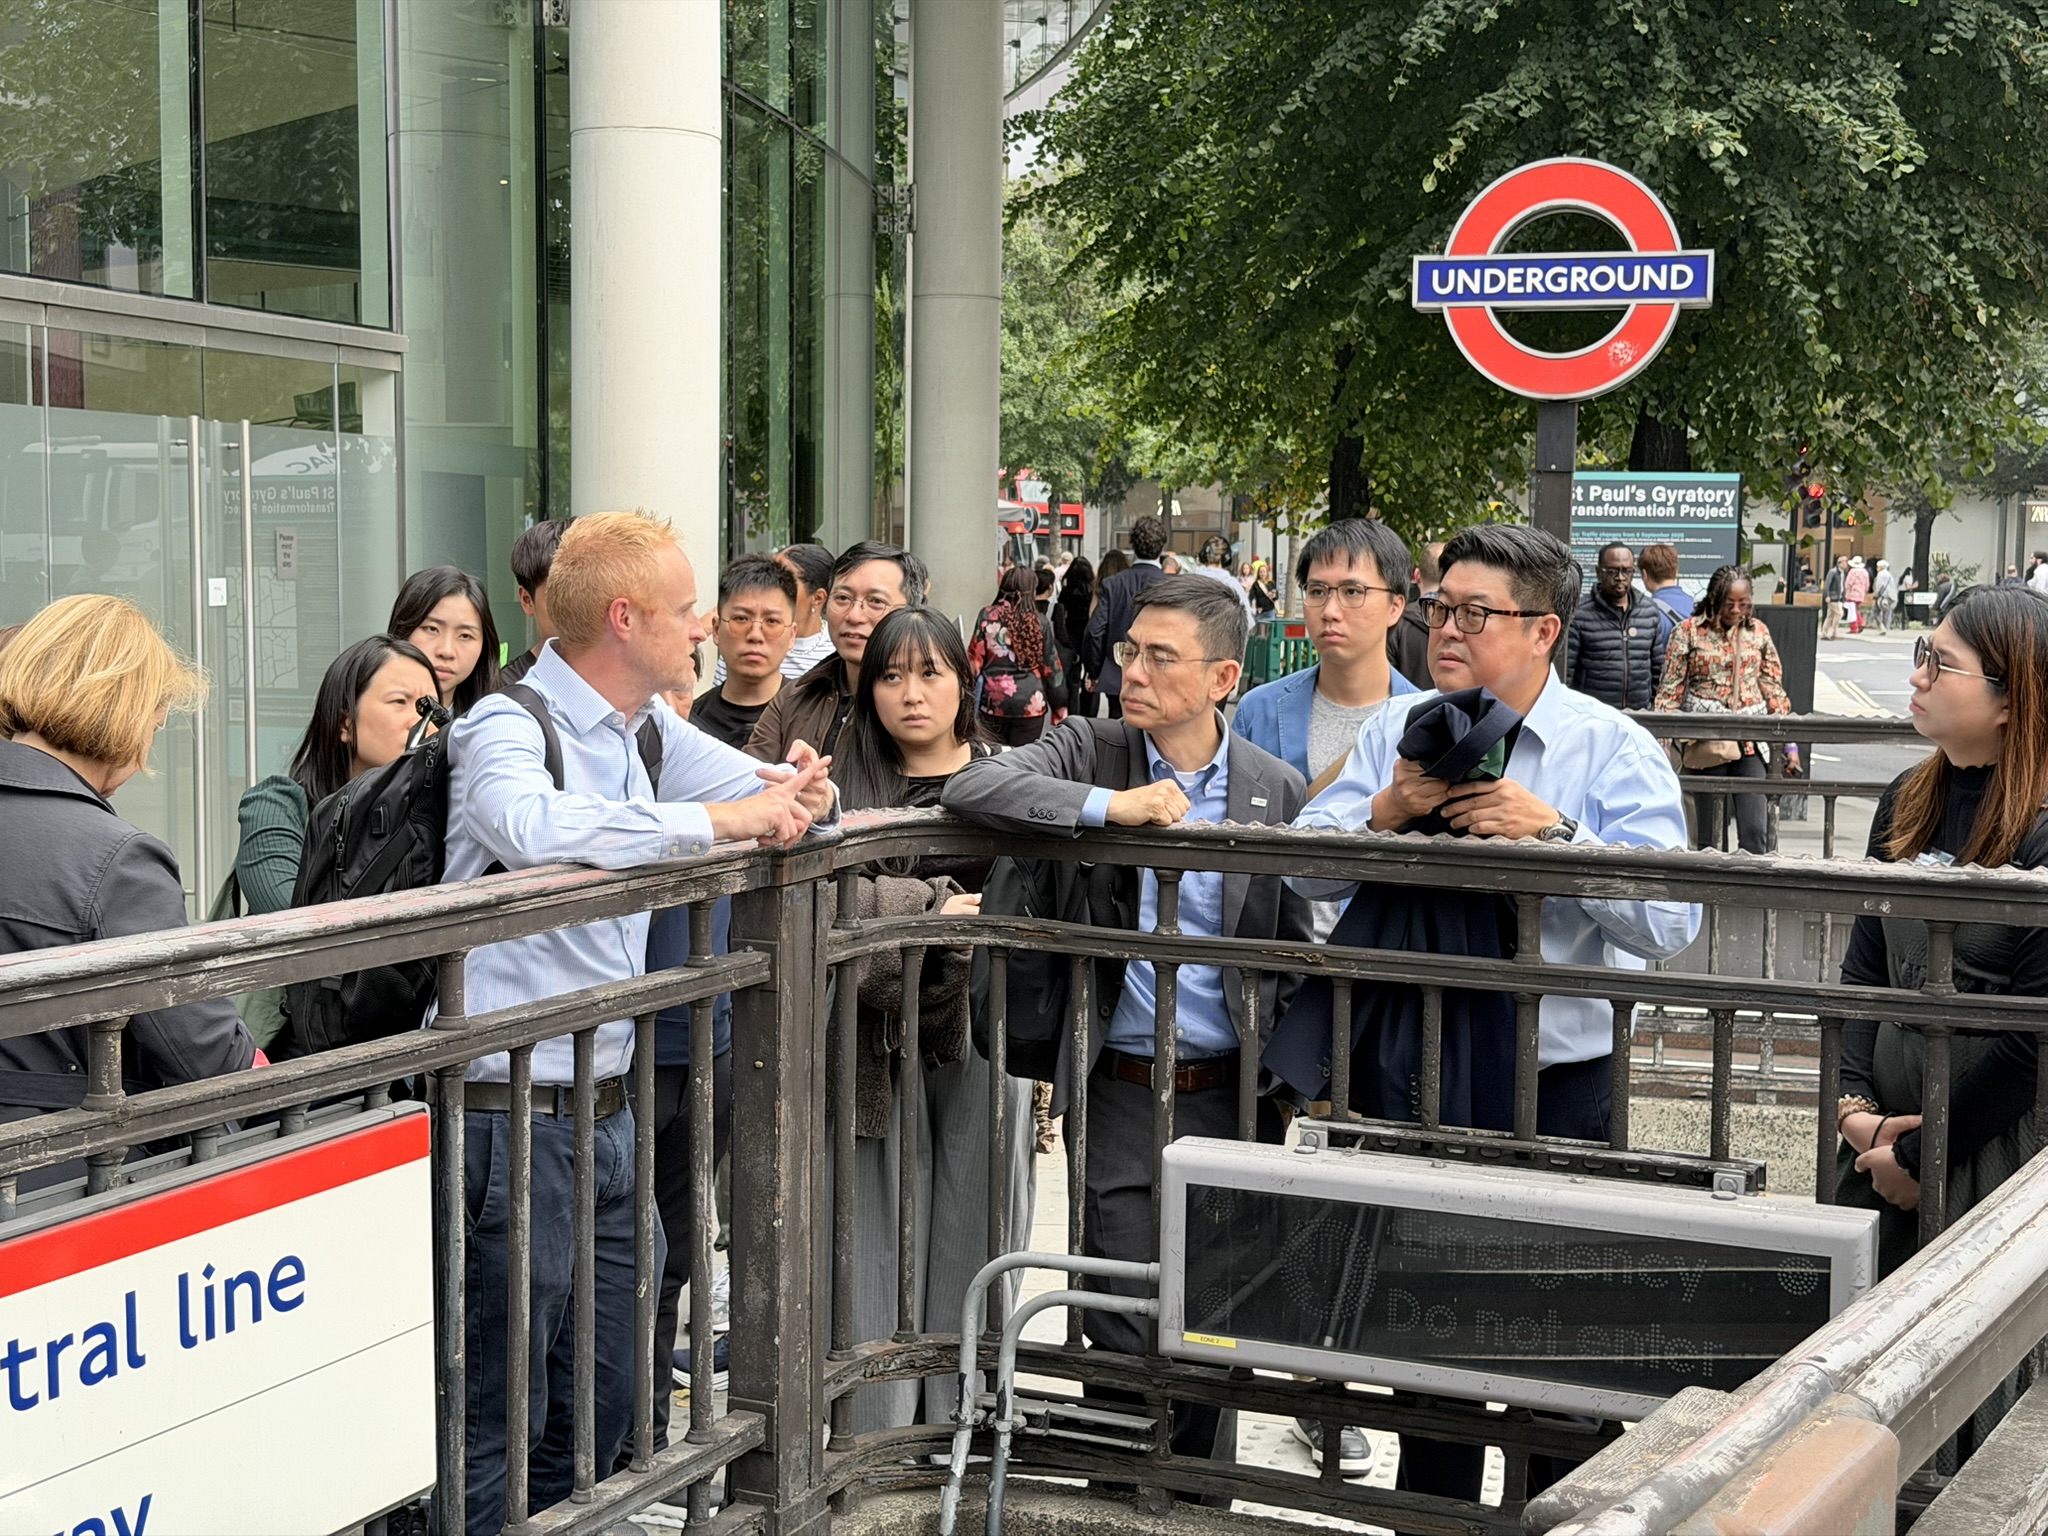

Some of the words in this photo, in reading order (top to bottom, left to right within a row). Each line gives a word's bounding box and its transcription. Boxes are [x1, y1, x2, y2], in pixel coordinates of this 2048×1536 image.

[1432, 263, 1694, 295] UNDERGROUND
[1589, 485, 1646, 502] Paul's
[1651, 485, 1736, 506] Gyratory
[1065, 516, 1072, 527] 8
[1571, 504, 1675, 517] ransformation
[1680, 504, 1734, 520] Project
[1401, 1212, 1709, 1303] Emergency
[0, 1290, 146, 1412] tral
[178, 1254, 306, 1350] line
[1387, 1287, 1458, 1338] Do
[1475, 1309, 1563, 1354] not
[1576, 1322, 1723, 1377] enter
